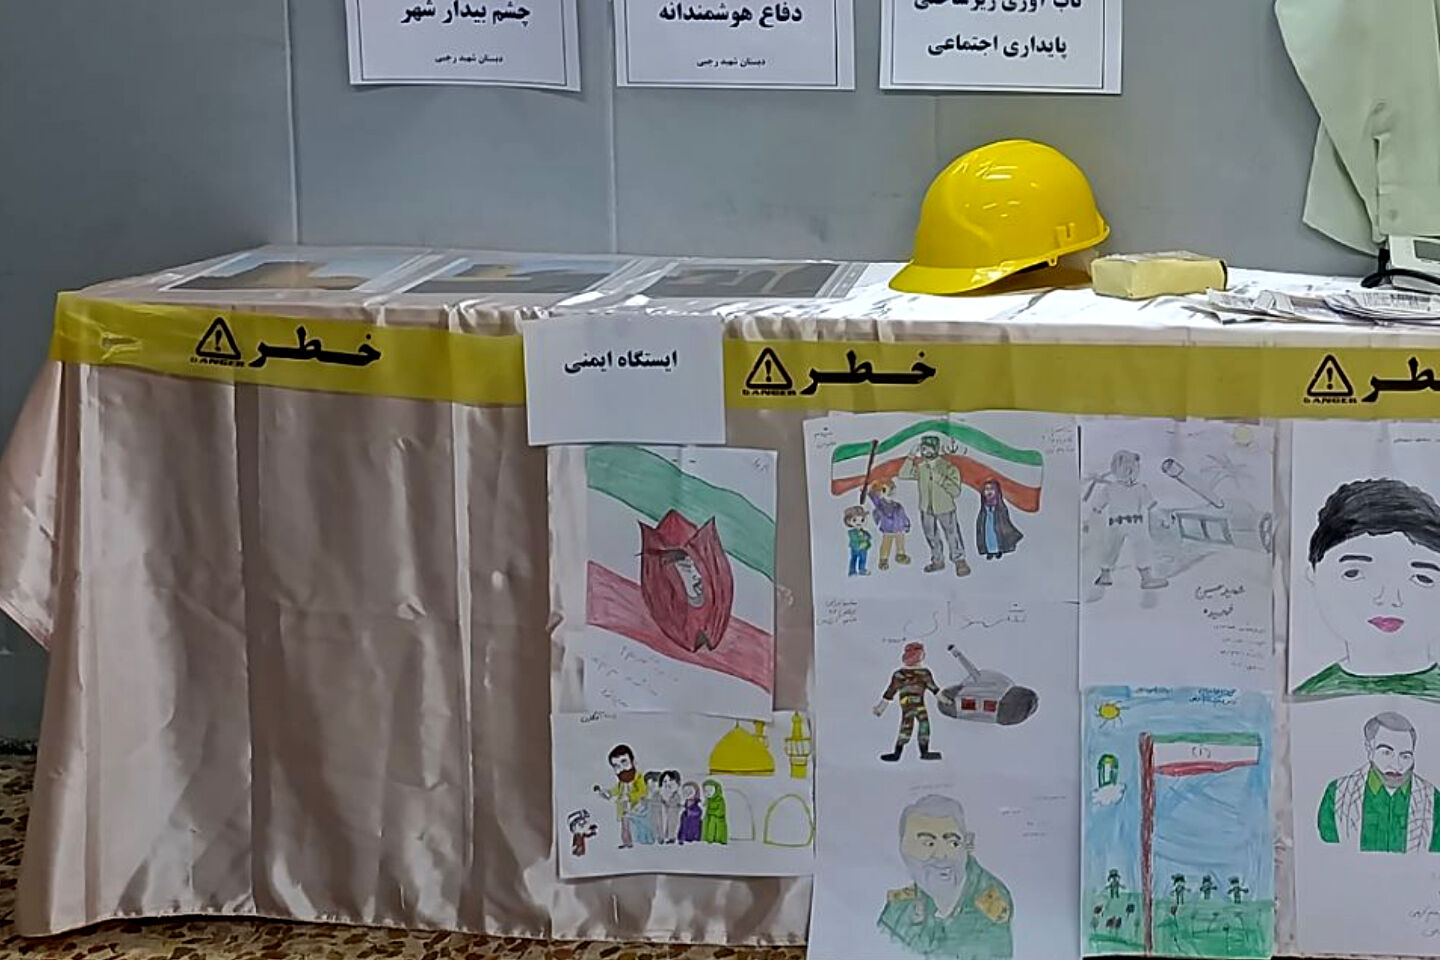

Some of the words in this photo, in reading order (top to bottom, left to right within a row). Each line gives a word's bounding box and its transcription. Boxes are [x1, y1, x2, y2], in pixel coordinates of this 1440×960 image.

[442, 0, 487, 24] بیدار
[492, 0, 531, 27] چشم
[659, 1, 753, 28] هوشمندانه
[759, 2, 802, 28] دفاع
[928, 34, 998, 56] اجتماعی
[1003, 36, 1067, 59] پایداری
[248, 326, 381, 368] خطر
[564, 350, 613, 375] ایمنی
[618, 349, 678, 374] ایستگاه
[799, 350, 937, 396] خطر
